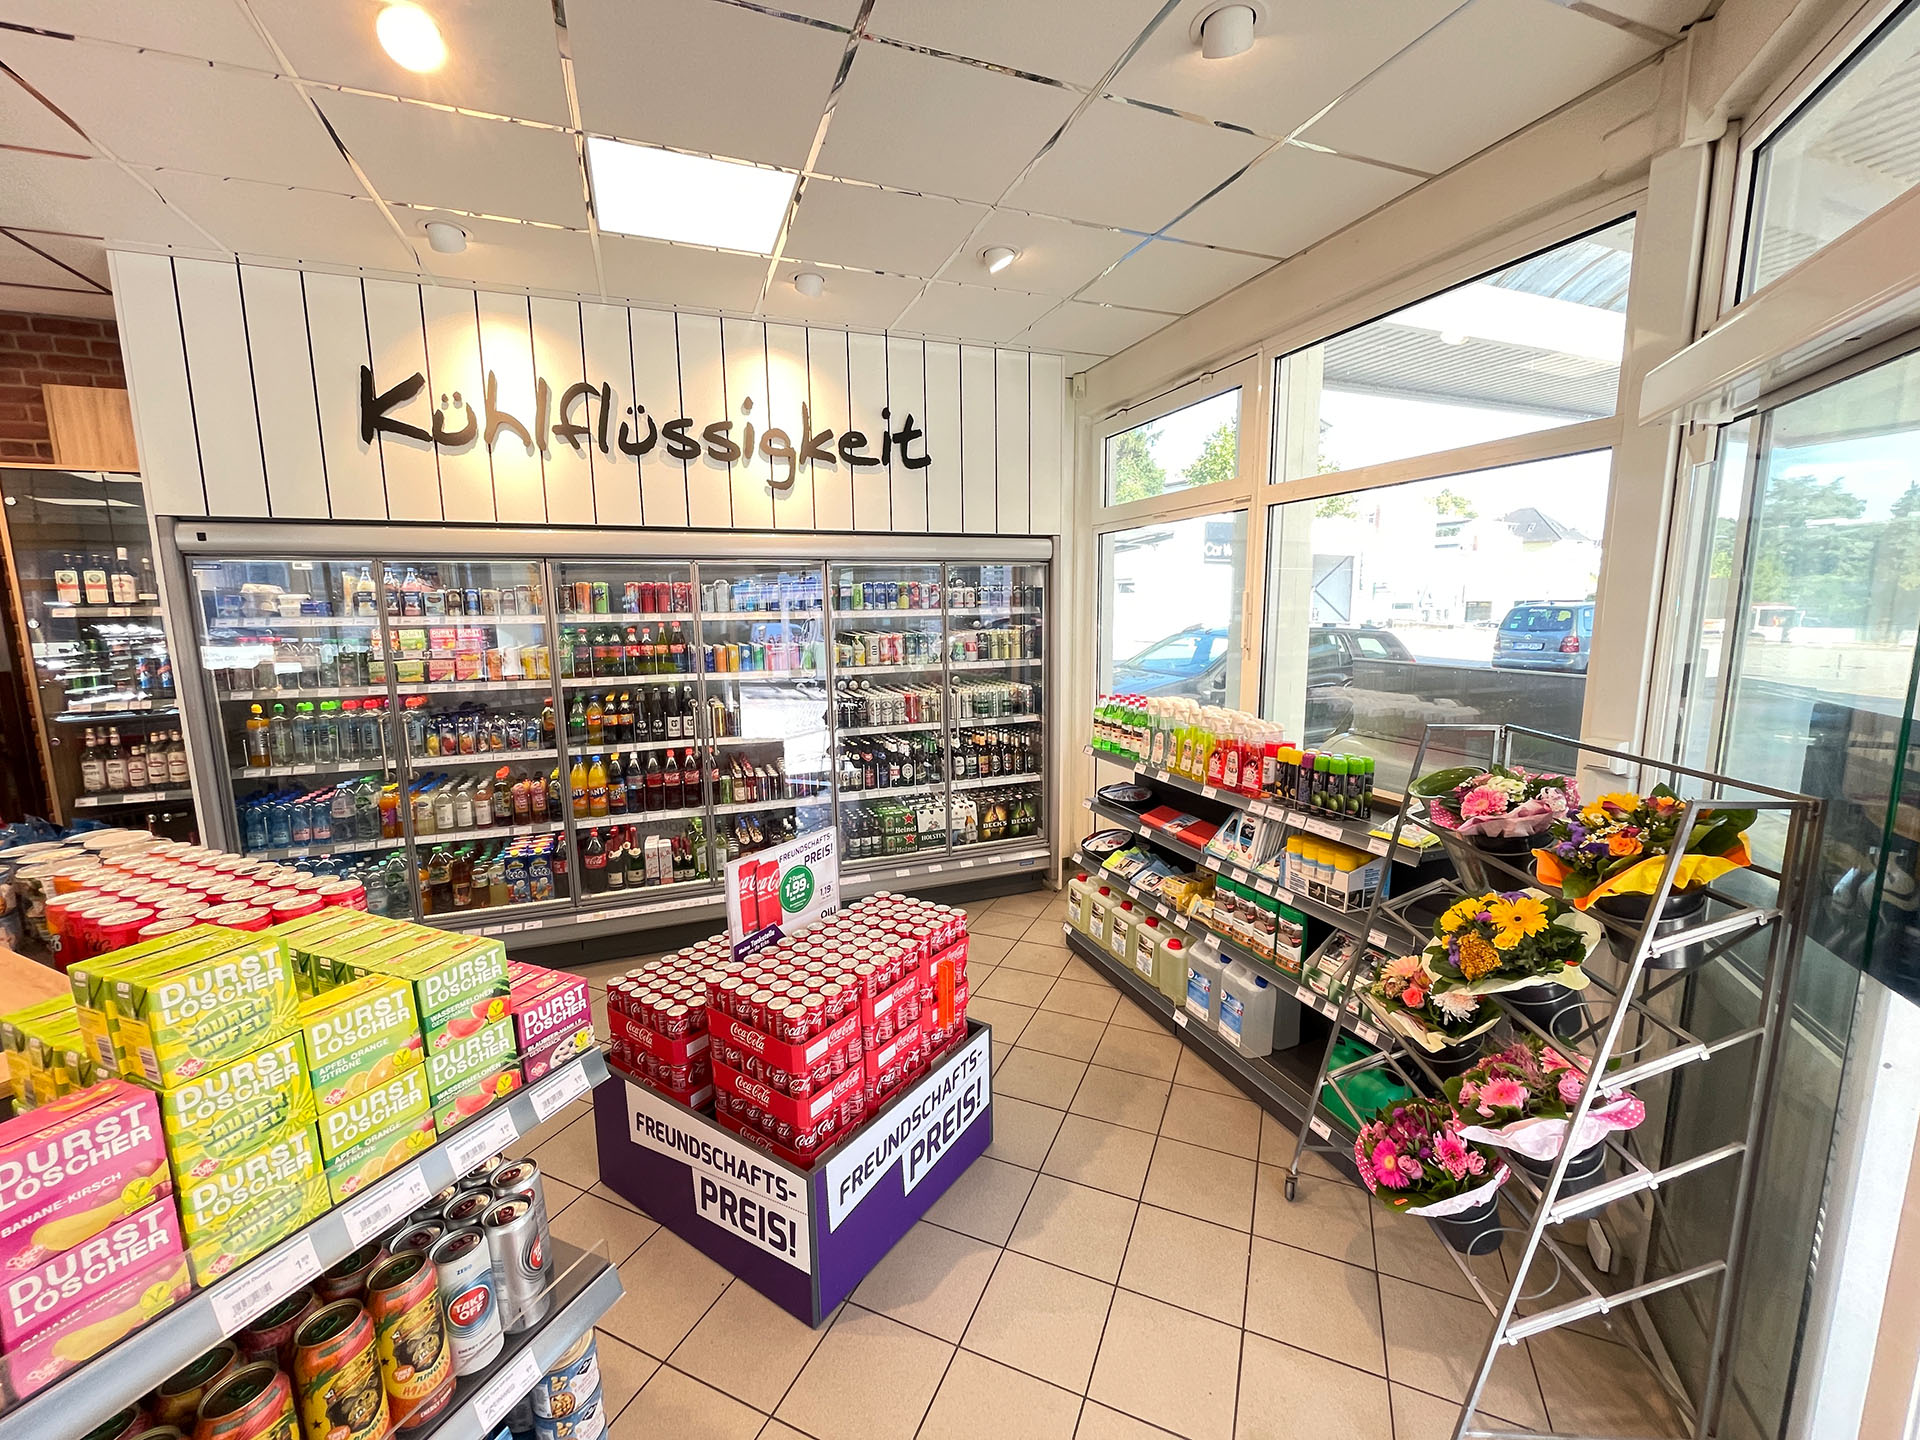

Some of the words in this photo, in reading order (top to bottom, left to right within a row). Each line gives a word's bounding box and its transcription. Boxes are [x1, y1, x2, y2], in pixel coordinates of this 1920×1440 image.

[360, 364, 932, 490] Kühlflüssigkeit
[779, 833, 832, 863] FREUNDSCHAFTS-
[983, 820, 1008, 830] BECK'S
[804, 843, 833, 866] PREIS!
[160, 946, 280, 1010] DURST
[163, 966, 285, 1025] LÖSCHER
[426, 948, 500, 996] DURST
[428, 965, 503, 1009] LÖSCHER
[312, 989, 407, 1046] DURST
[430, 987, 494, 1024] WASSERMELONEN
[523, 984, 585, 1028] DURST
[525, 999, 587, 1041] LÖSCHER
[626, 1020, 653, 1045] Coca-Cola
[315, 1007, 411, 1060] LÖSCHER
[319, 1057, 348, 1076] APFEL
[350, 1037, 390, 1060] ORANGE
[432, 1021, 507, 1074] DURST
[730, 1022, 766, 1050] Coca-Cola
[176, 1041, 295, 1114] DURST
[320, 1058, 362, 1083] ZITRONE
[435, 1038, 510, 1087] LÖSCHER
[735, 1075, 771, 1104] Coca-Cola
[180, 1062, 300, 1128] LÖSCHER
[328, 1071, 418, 1135] DURST
[331, 1088, 422, 1149] LÖSCHER
[0, 1102, 147, 1191] DURST
[839, 1048, 983, 1206] FREUNDSCHAFTS-
[909, 1076, 982, 1183] PREIS!
[192, 1131, 308, 1210] DURST
[636, 1111, 797, 1201] FREUNDSCHAFTS-
[1, 1172, 122, 1238] BANANE-KIRSCH
[196, 1151, 314, 1226] LÖSCHER
[700, 1176, 797, 1258] PREIS!
[9, 1206, 165, 1310] DURST
[13, 1229, 170, 1328] LÖSCHER
[454, 1290, 485, 1314] TAKE
[459, 1300, 484, 1321] OFF
